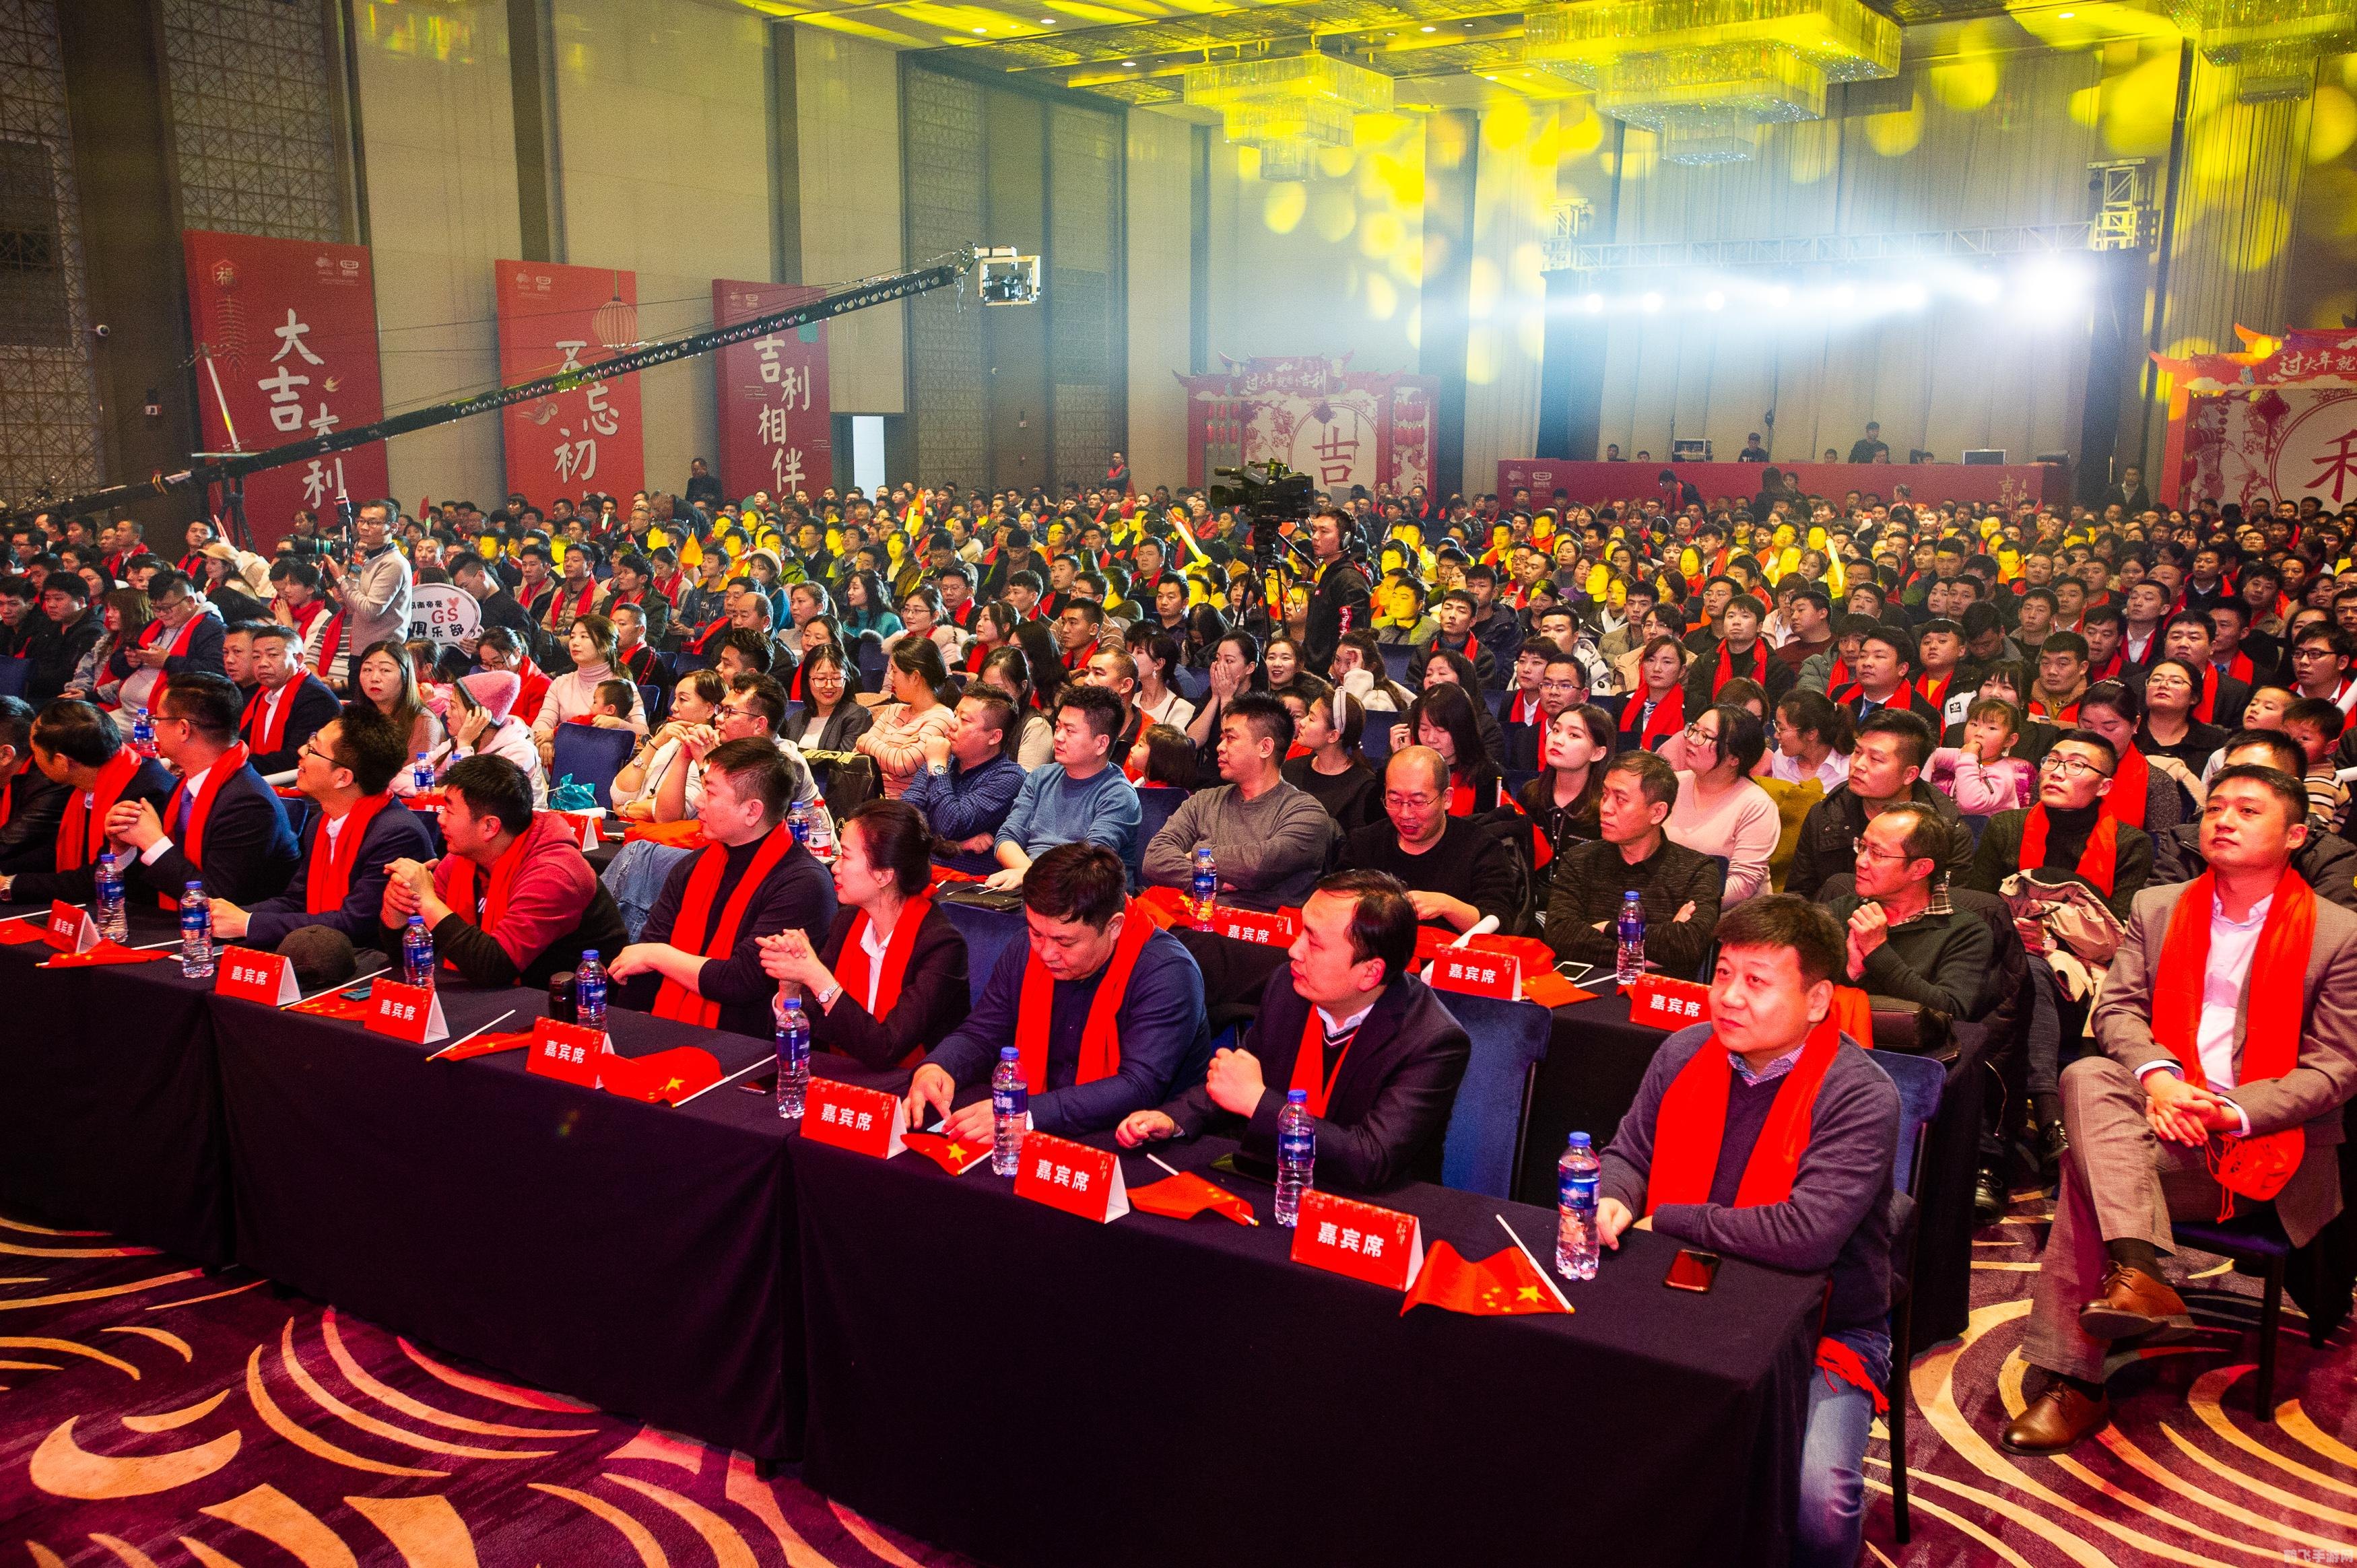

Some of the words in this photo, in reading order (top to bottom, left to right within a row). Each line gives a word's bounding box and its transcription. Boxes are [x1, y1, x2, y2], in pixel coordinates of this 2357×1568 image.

[215, 266, 234, 285] 福
[553, 340, 619, 502] 不忘初
[754, 333, 809, 494] 吉利相伴
[1312, 426, 1360, 486] 吉
[431, 607, 459, 624] GS
[411, 621, 465, 638] 俱乐部
[1228, 924, 1270, 943] 嘉宾席
[231, 965, 268, 986] 嘉宾席
[1448, 963, 1496, 984] 嘉宾席
[380, 999, 416, 1021] 嘉宾席
[1650, 994, 1701, 1017] 嘉宾席
[544, 1039, 586, 1064] 嘉宾席
[821, 1103, 873, 1131] 嘉宾席
[1036, 1159, 1090, 1192] 嘉宾席
[1317, 1221, 1385, 1258] 嘉宾席
